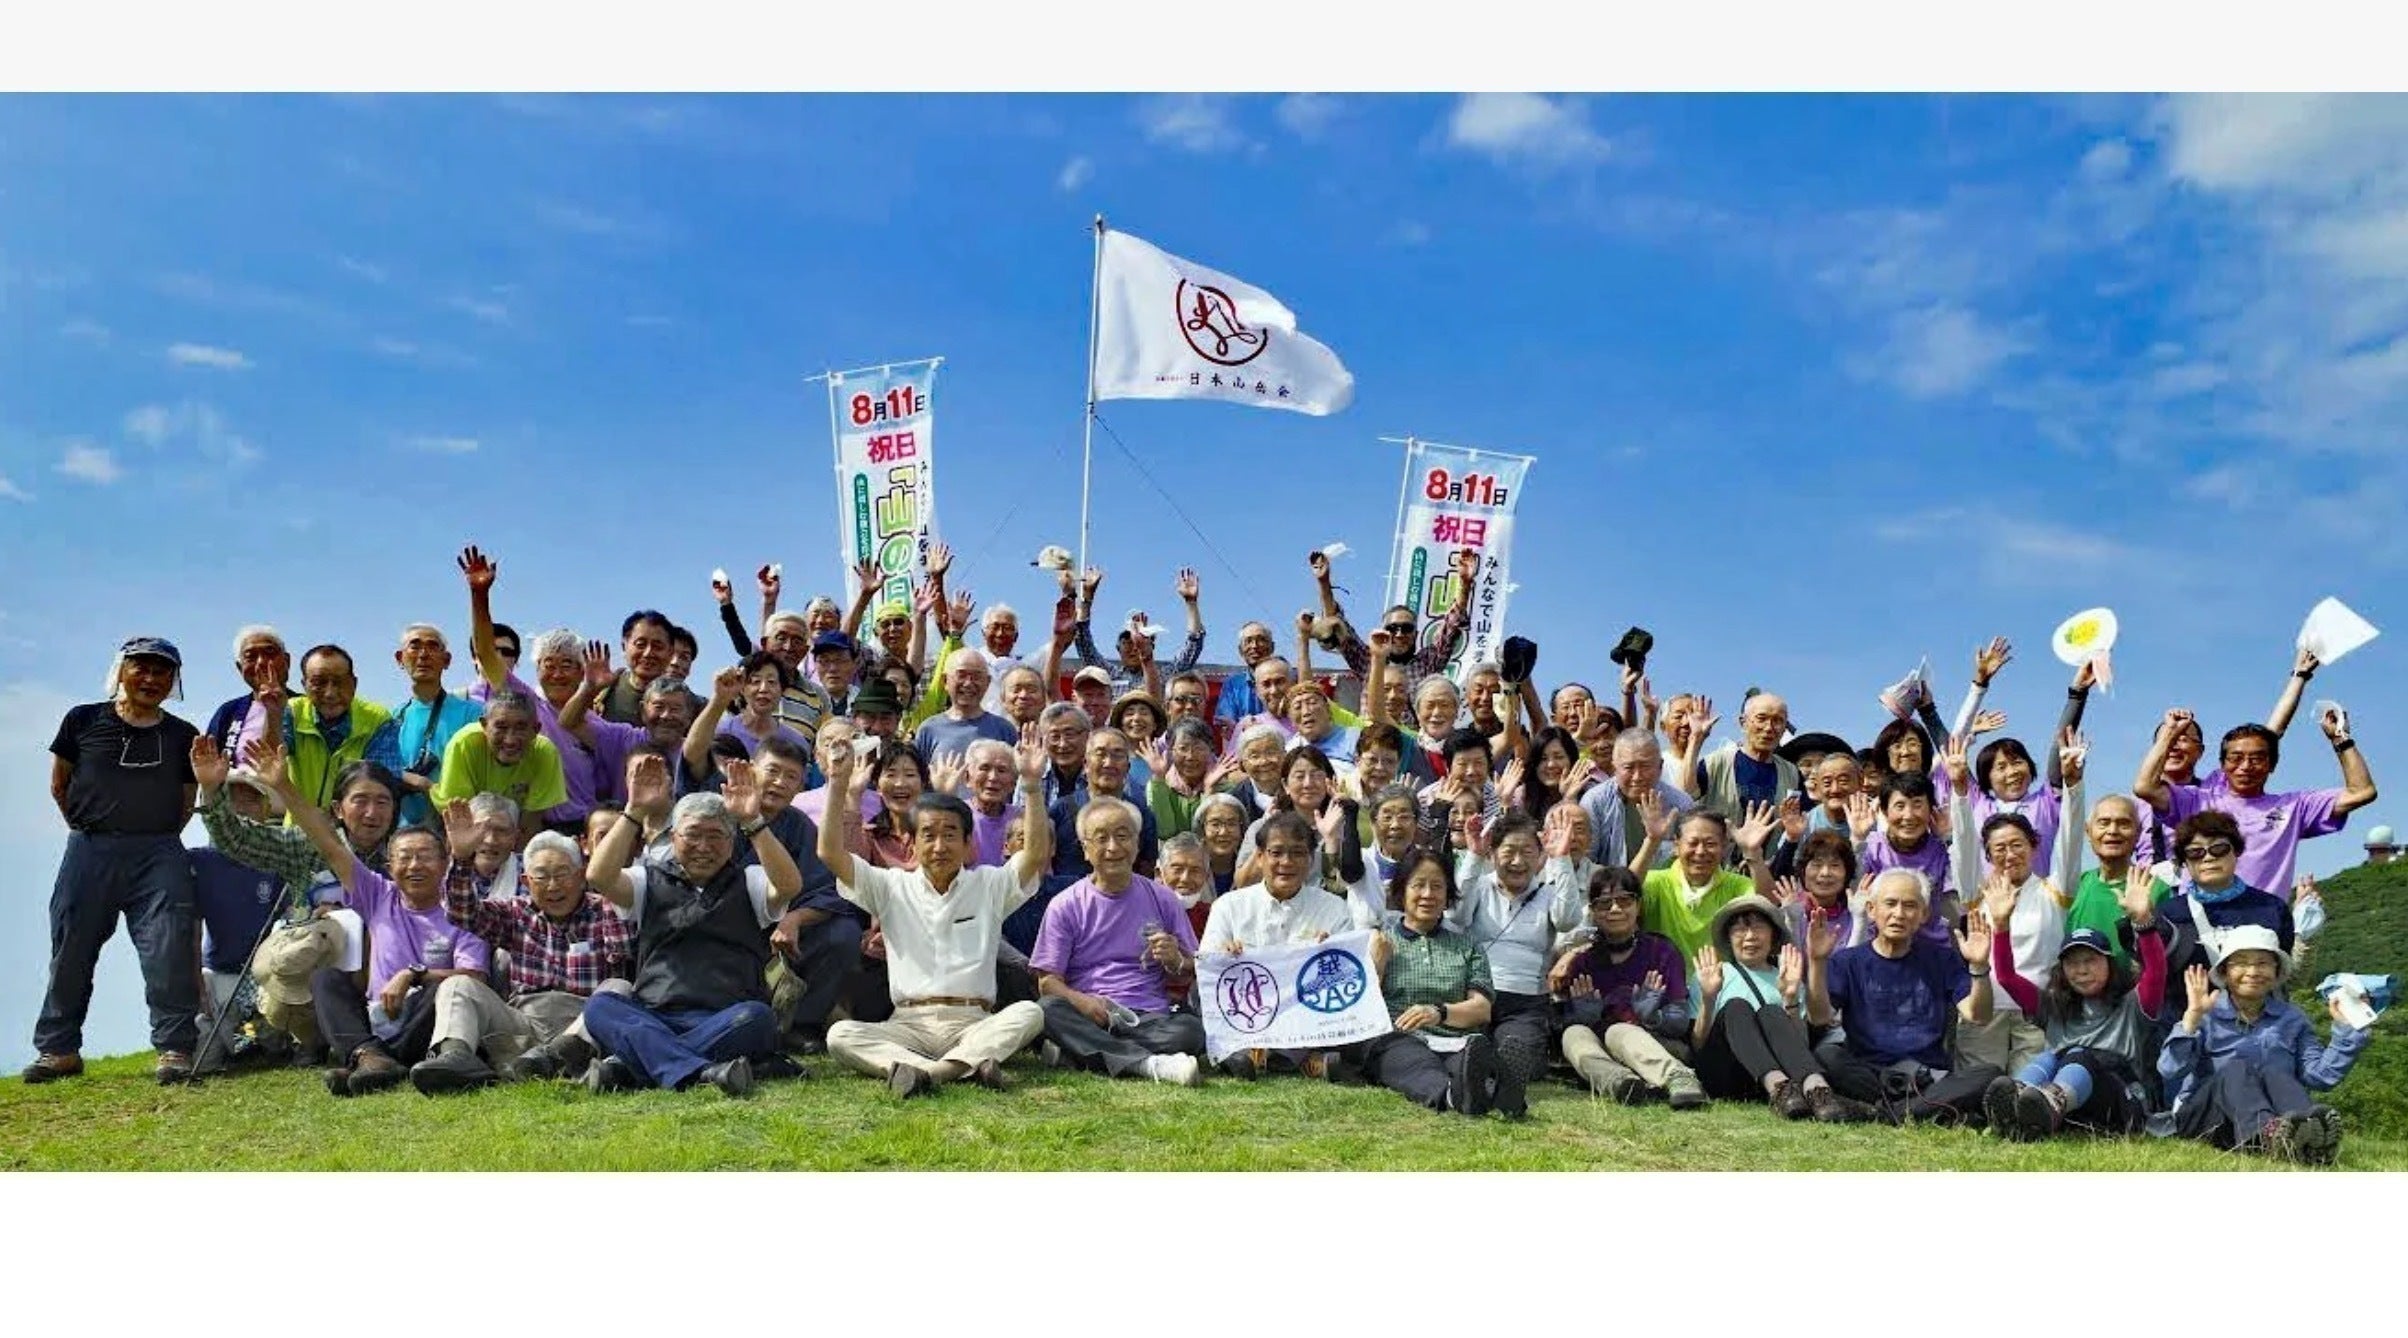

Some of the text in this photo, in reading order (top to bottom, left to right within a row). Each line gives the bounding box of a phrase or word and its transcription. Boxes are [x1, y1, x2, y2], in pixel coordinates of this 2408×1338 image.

[1190, 372, 1290, 398] 日本山岳会
[852, 385, 925, 425] 8月11日
[867, 431, 917, 464] 祝日
[1426, 468, 1508, 507] 8月11日
[1433, 515, 1487, 547] 祝日
